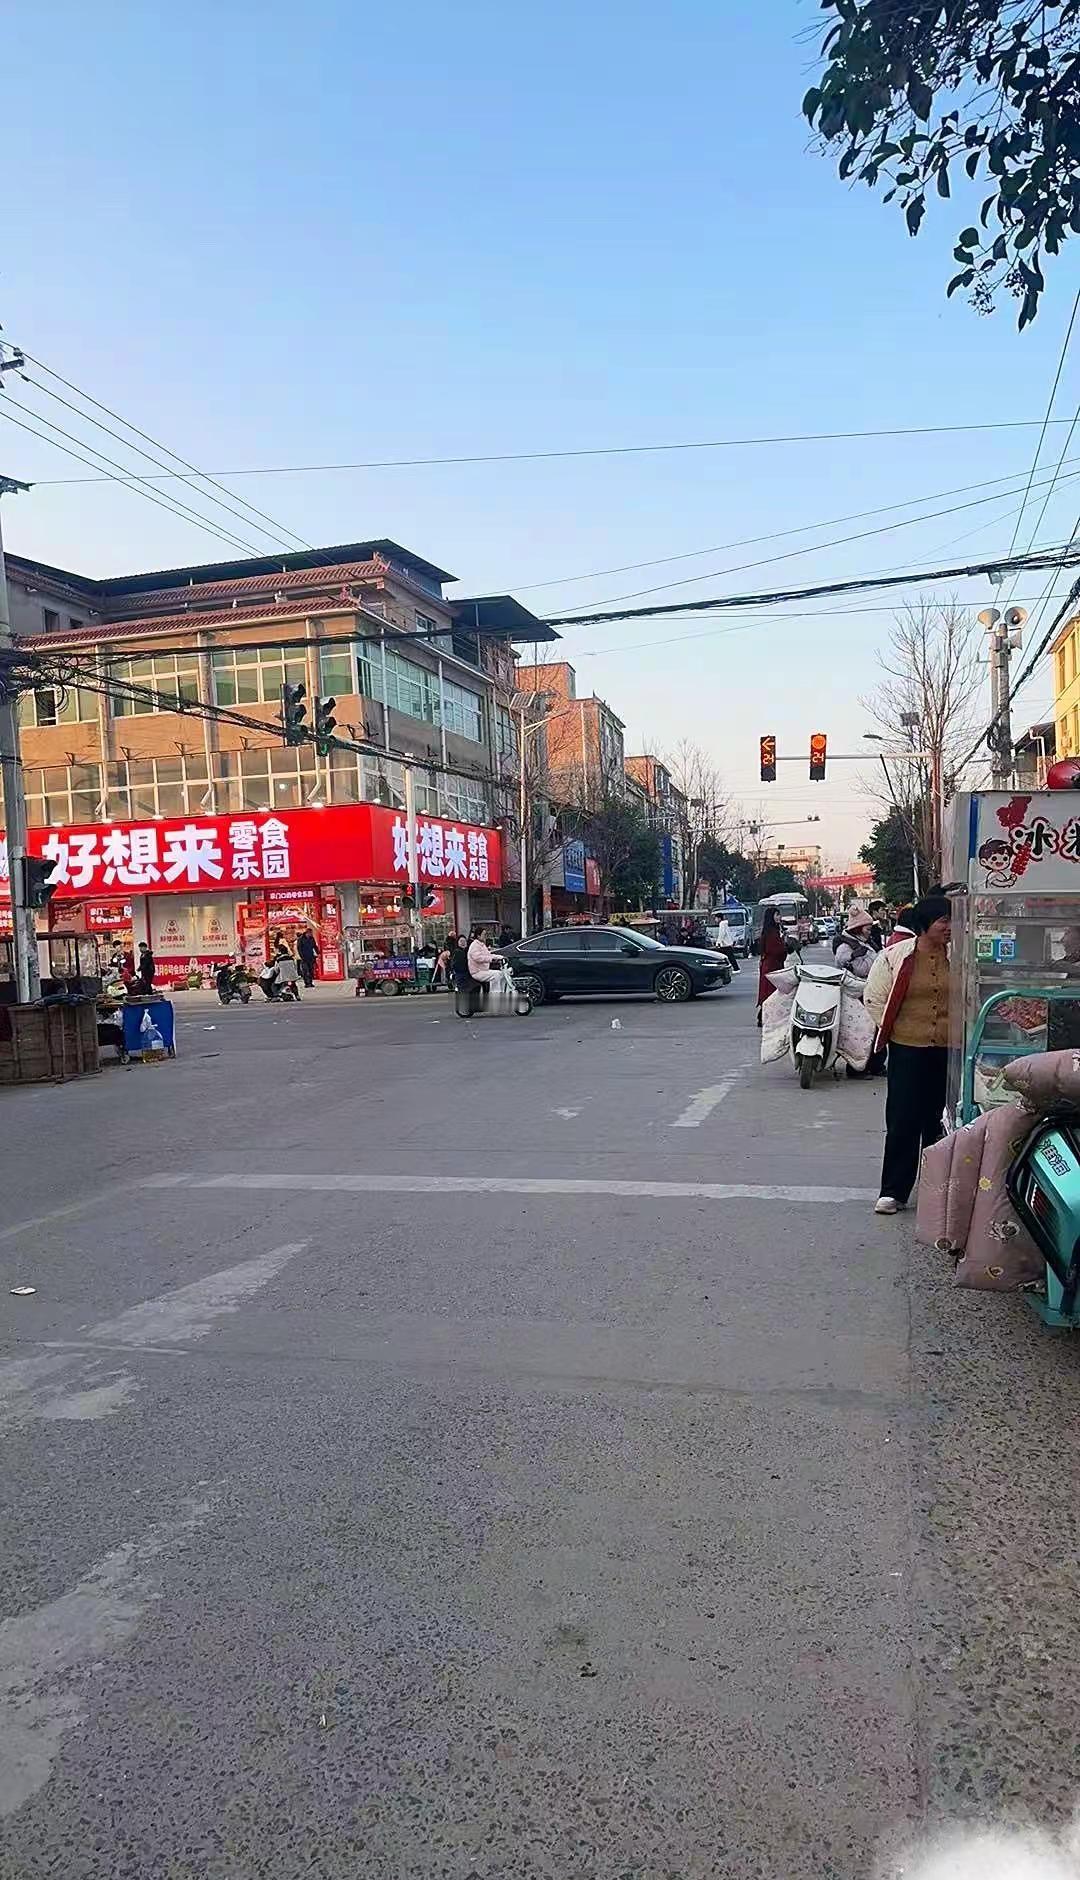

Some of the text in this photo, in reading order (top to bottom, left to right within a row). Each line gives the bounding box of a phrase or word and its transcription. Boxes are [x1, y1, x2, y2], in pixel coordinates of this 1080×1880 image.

[228, 818, 289, 850] 零食
[391, 816, 468, 879] 好想来
[467, 831, 488, 857] 零食
[41, 824, 224, 889] 好想来
[231, 849, 291, 881] 乐园
[469, 857, 489, 882] 乐园
